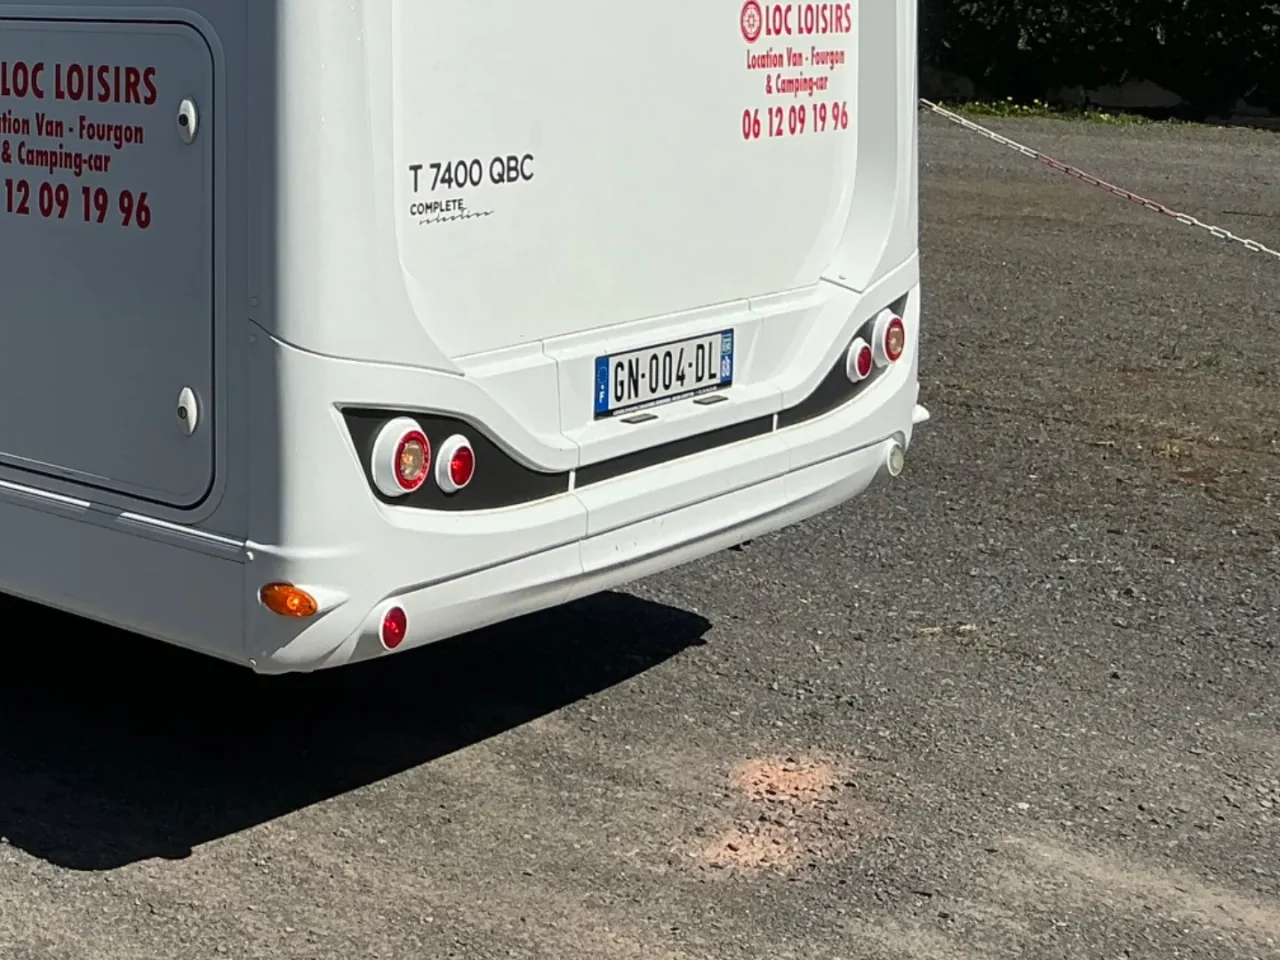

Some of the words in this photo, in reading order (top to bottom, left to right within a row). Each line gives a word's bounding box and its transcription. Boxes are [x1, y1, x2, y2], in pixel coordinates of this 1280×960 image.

[766, 4, 792, 35] LOC
[798, 3, 851, 35] LOISIRS
[747, 47, 783, 70] Location
[786, 47, 803, 67] Van
[811, 46, 845, 71] Fourgon
[1, 61, 44, 99] LOC
[55, 63, 157, 105] LOISIRS
[776, 71, 828, 98] Camping-car
[36, 112, 63, 138] Van
[79, 115, 143, 150] Fourgon
[742, 109, 761, 140] 06
[768, 106, 783, 137] 12
[788, 104, 806, 135] 09
[813, 103, 827, 133] 19
[832, 101, 848, 131] 96
[1, 140, 12, 164] &
[18, 141, 111, 177] Camping-car
[409, 164, 423, 193] T
[429, 158, 483, 191] 7400
[489, 153, 534, 184] QBC
[5, 178, 30, 215] 12
[39, 182, 69, 219] 09
[82, 186, 108, 223] 19
[118, 190, 151, 229] 96
[410, 198, 464, 216] COMPLETE
[614, 341, 717, 402] GN-004-DL
